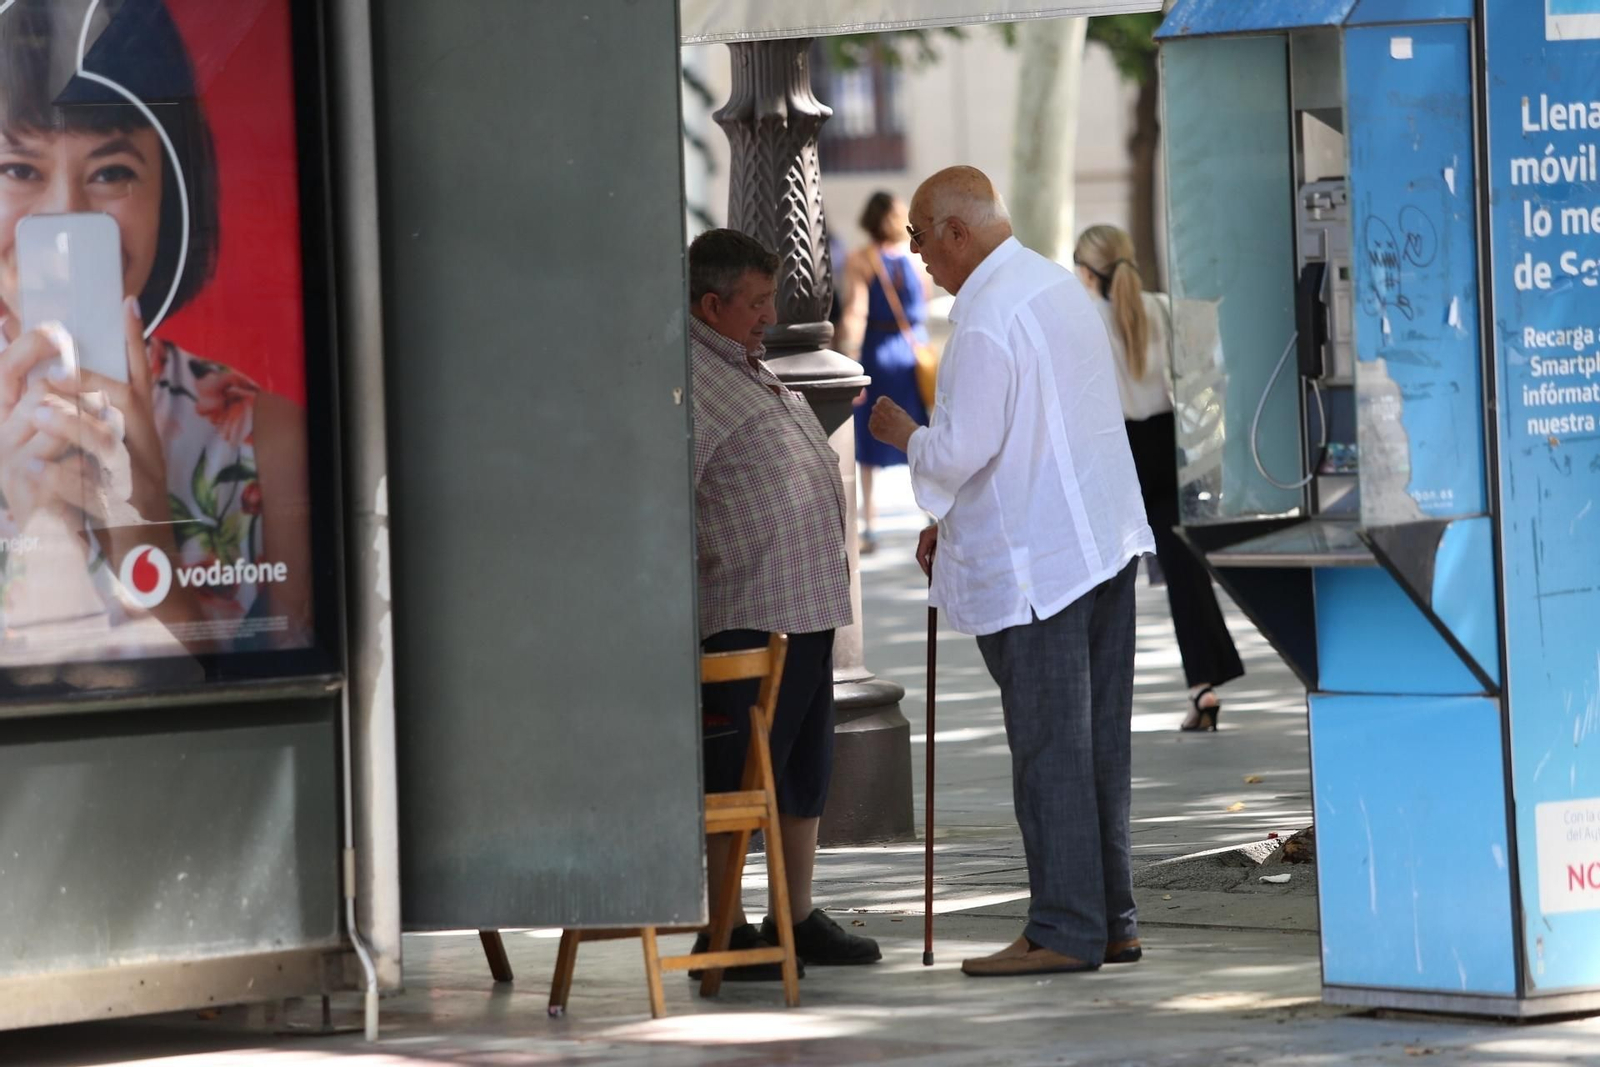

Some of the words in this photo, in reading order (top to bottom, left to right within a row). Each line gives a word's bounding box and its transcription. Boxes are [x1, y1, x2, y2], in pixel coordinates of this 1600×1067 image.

[1521, 93, 1600, 132] Llena
[1510, 142, 1597, 185] móvil
[1523, 199, 1552, 237] lo
[1514, 252, 1552, 290] de
[1560, 250, 1600, 287] Se
[1523, 326, 1595, 351] Recarga
[1527, 412, 1595, 435] nuestra
[176, 558, 288, 588] vodafone
[1563, 809, 1584, 825] Con
[1586, 807, 1595, 823] la
[1566, 826, 1582, 843] del
[1584, 825, 1600, 844] Ay
